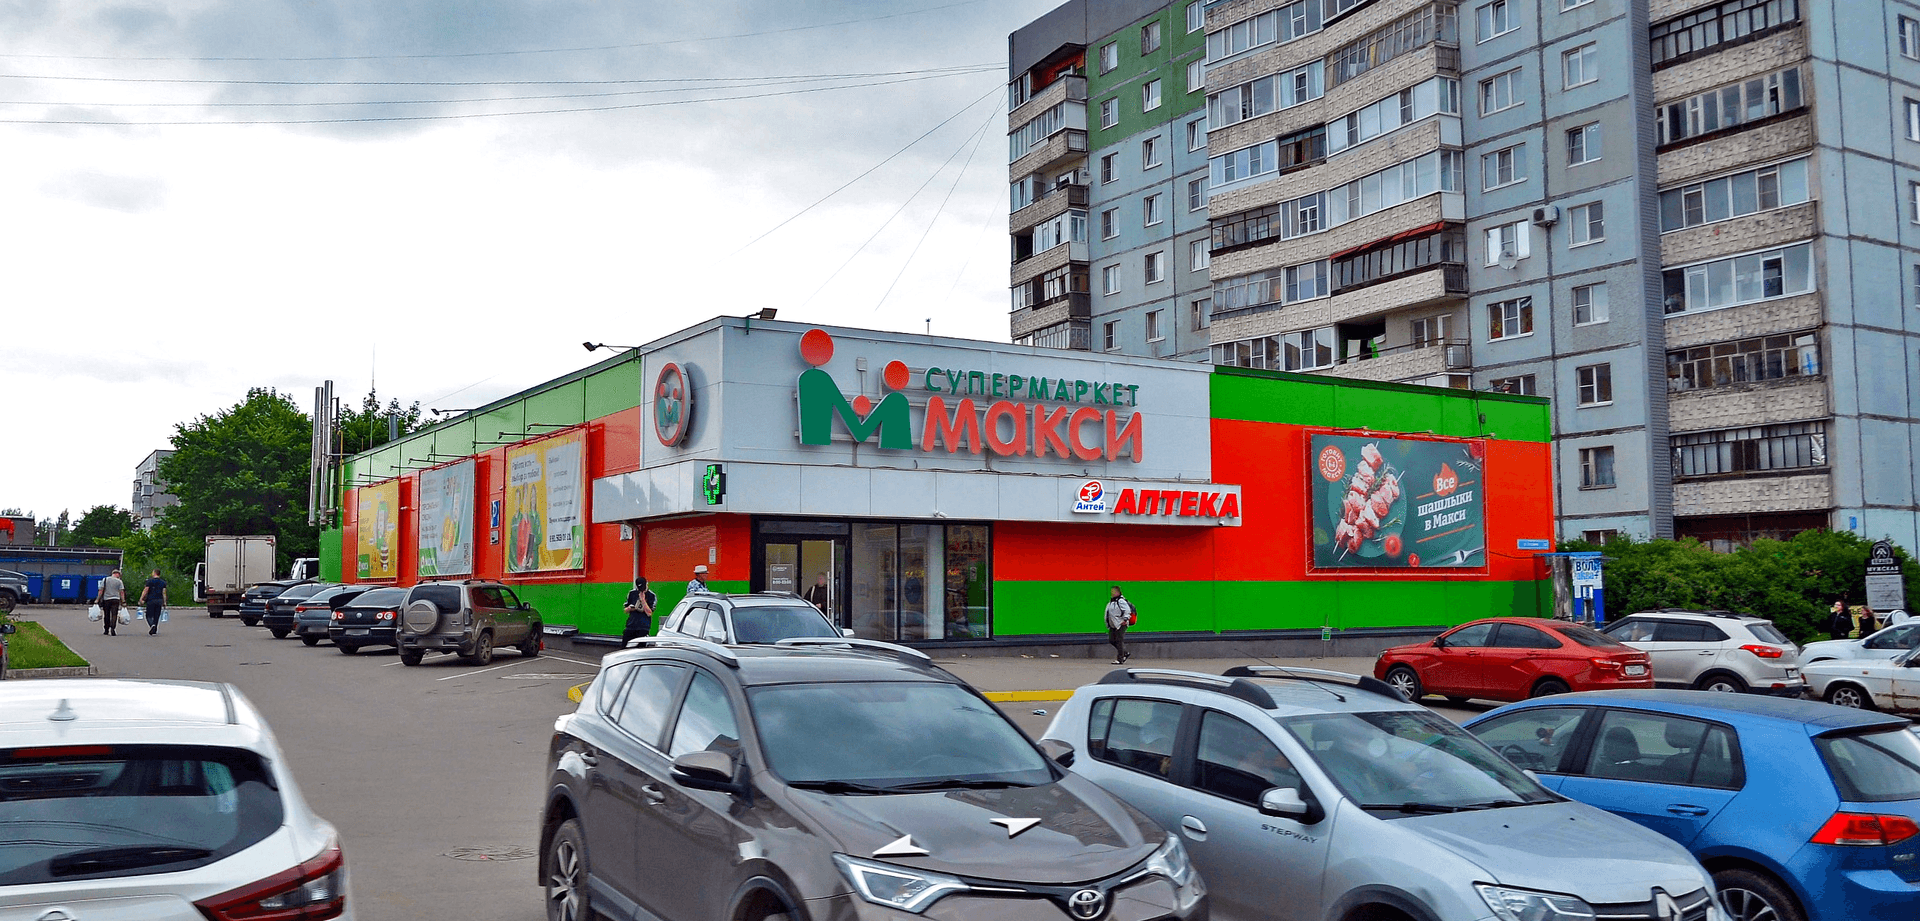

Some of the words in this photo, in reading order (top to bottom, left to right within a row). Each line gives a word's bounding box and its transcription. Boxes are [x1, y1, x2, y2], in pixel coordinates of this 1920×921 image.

[925, 367, 1140, 407] СУПЕРМАРКЕТ
[1436, 477, 1455, 492] Все
[1076, 501, 1104, 511] Антей
[1114, 488, 1240, 517] АПТЕКА
[1417, 491, 1473, 517] шашлыки
[1425, 521, 1431, 531] в
[1432, 509, 1466, 528] Макси
[1261, 823, 1318, 844] STEPWAY
